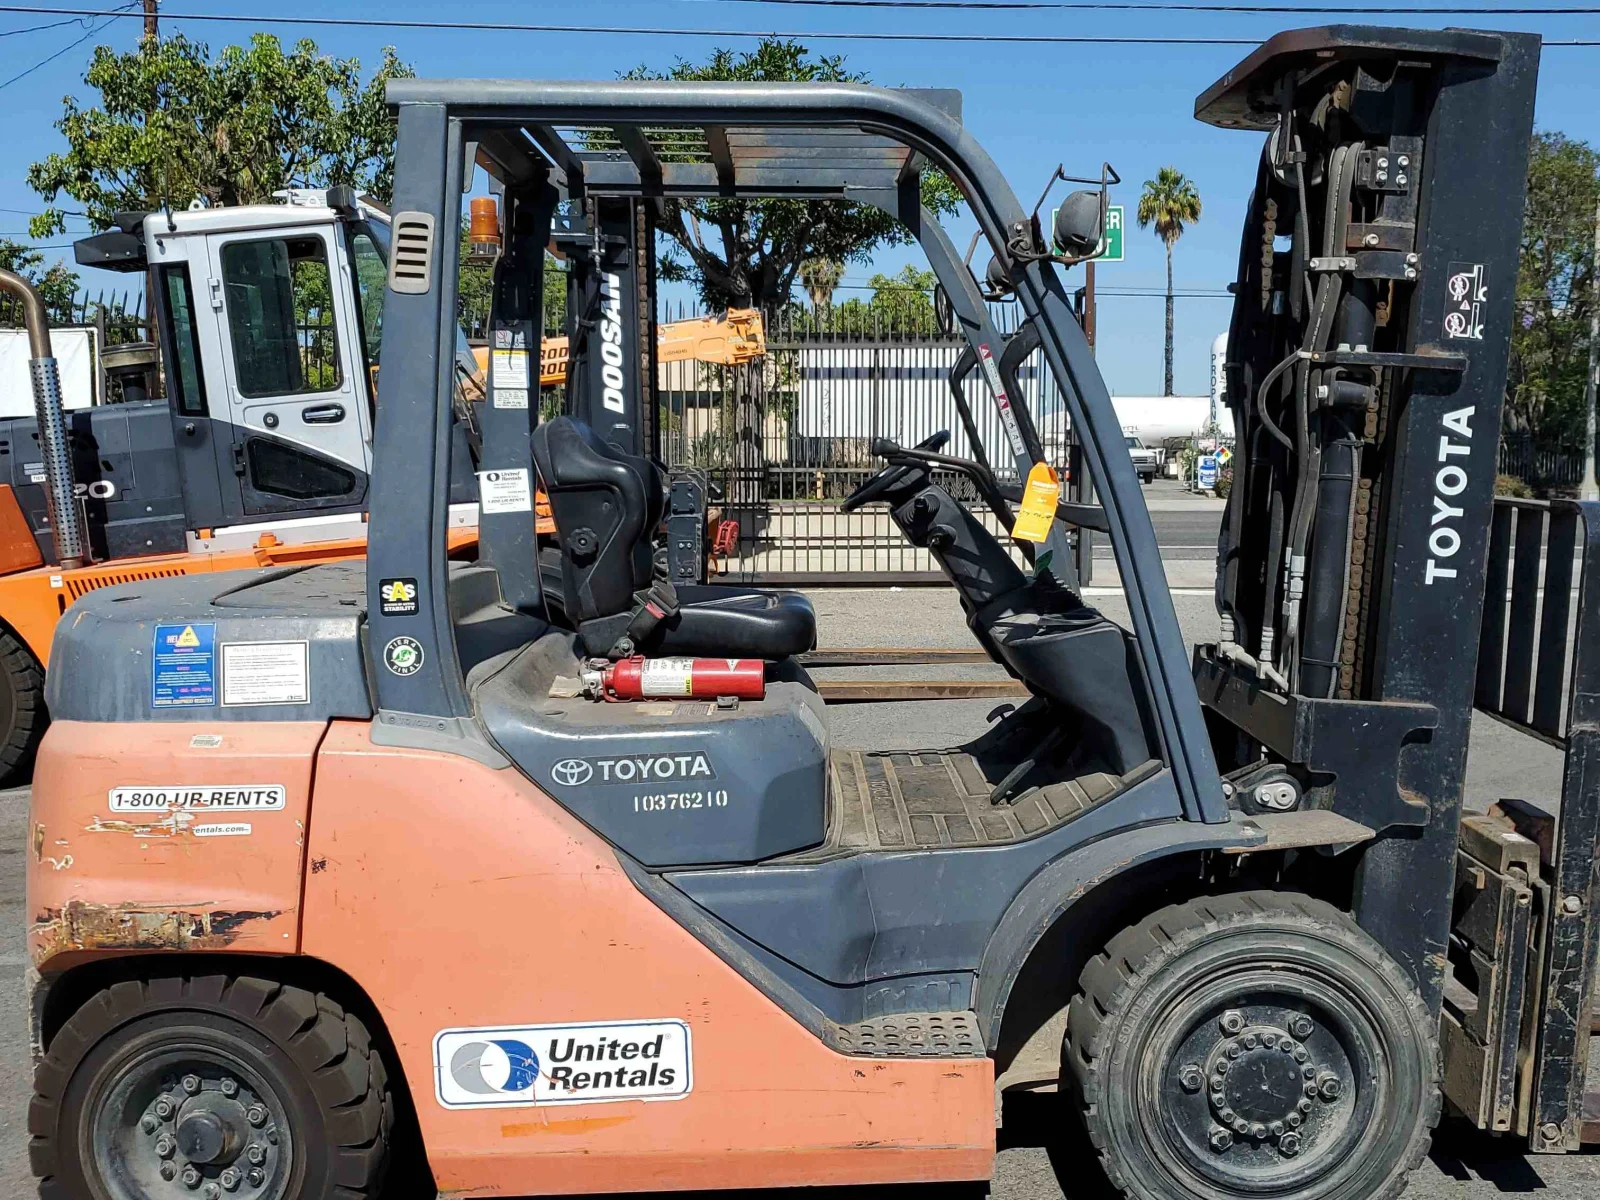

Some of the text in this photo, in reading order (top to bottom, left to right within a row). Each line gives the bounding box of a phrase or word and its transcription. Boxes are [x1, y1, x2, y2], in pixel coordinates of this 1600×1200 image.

[600, 271, 625, 415] DOOSAN
[1425, 405, 1476, 585] TOYOTA
[382, 581, 416, 602] SAS
[388, 638, 409, 650] TIER
[392, 662, 420, 674] FINAL
[598, 756, 711, 781] TOYOTA
[115, 790, 278, 807] 1-800-UR-RENTS
[634, 790, 728, 812] 10376210
[1118, 986, 1159, 1045] SOLIDEAL
[548, 1034, 664, 1062] United
[549, 1062, 676, 1090] Rentals
